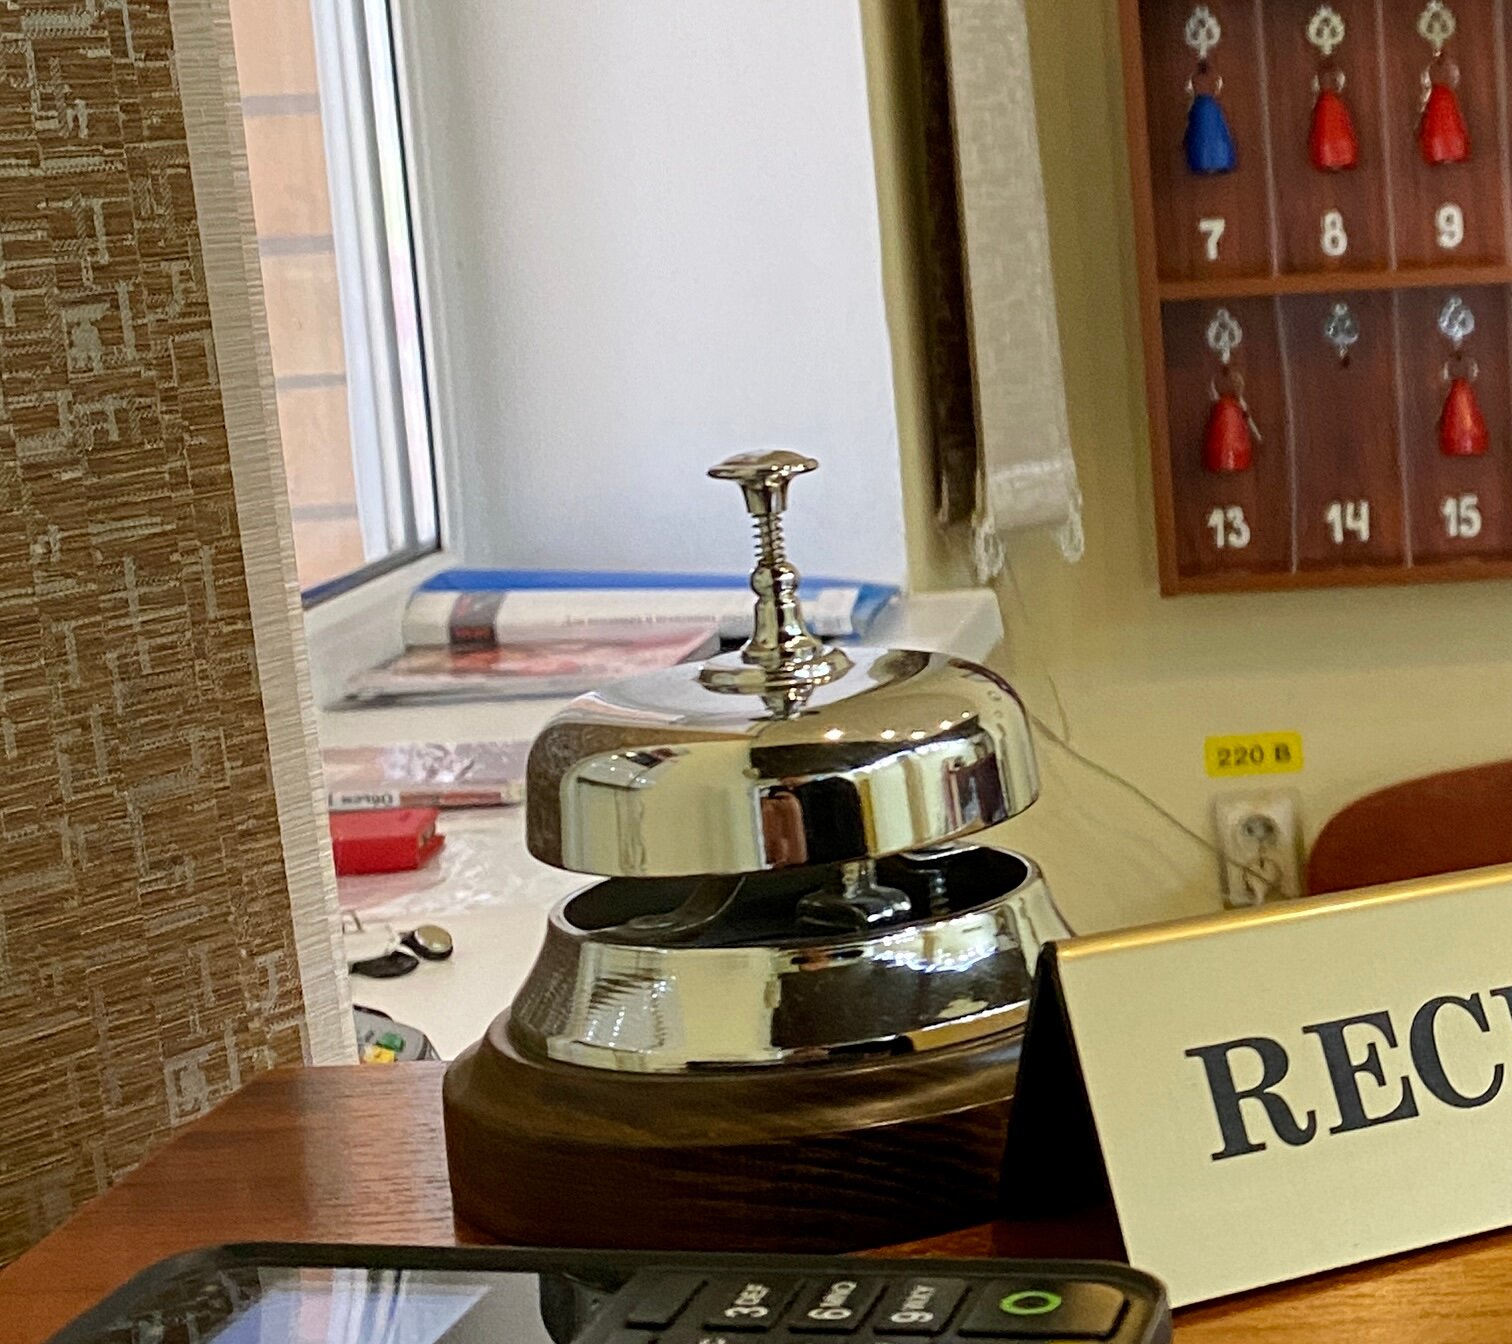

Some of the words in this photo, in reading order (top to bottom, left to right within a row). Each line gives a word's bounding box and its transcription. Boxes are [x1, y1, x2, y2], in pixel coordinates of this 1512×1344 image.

[1199, 218, 1227, 260] 7
[1320, 209, 1348, 257] 8
[1435, 203, 1465, 250] 9
[1207, 505, 1251, 550] 13
[1326, 500, 1371, 543] 14
[1440, 494, 1483, 538] 15
[1217, 745, 1265, 767] 220
[1274, 742, 1292, 764] В
[724, 1306, 769, 1319] 3
[808, 1307, 853, 1320] 6
[891, 1310, 935, 1324] 9
